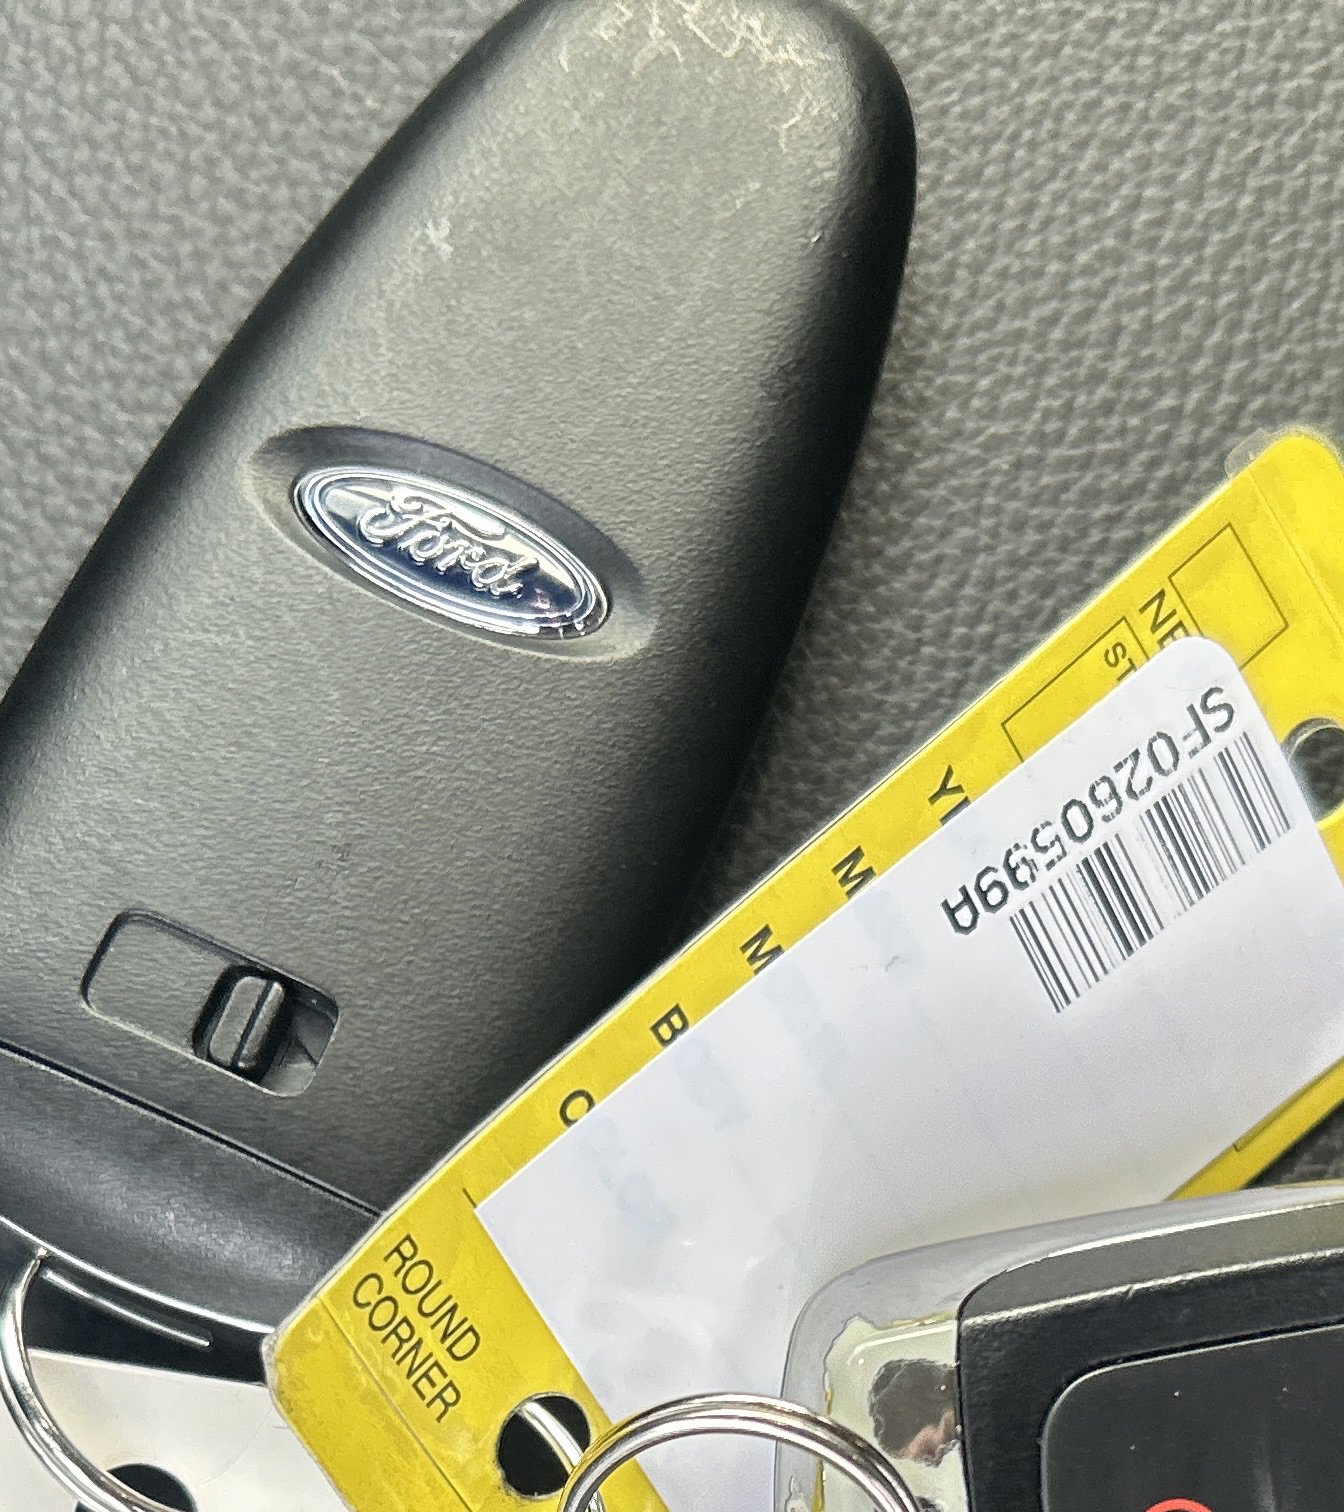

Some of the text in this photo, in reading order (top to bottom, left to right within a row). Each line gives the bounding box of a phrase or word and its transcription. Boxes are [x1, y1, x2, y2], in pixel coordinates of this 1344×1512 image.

[355, 485, 540, 599] Ford
[939, 686, 1236, 935] SF0260599A
[353, 1272, 462, 1424] CORNER
[384, 1233, 481, 1362] ROUND
